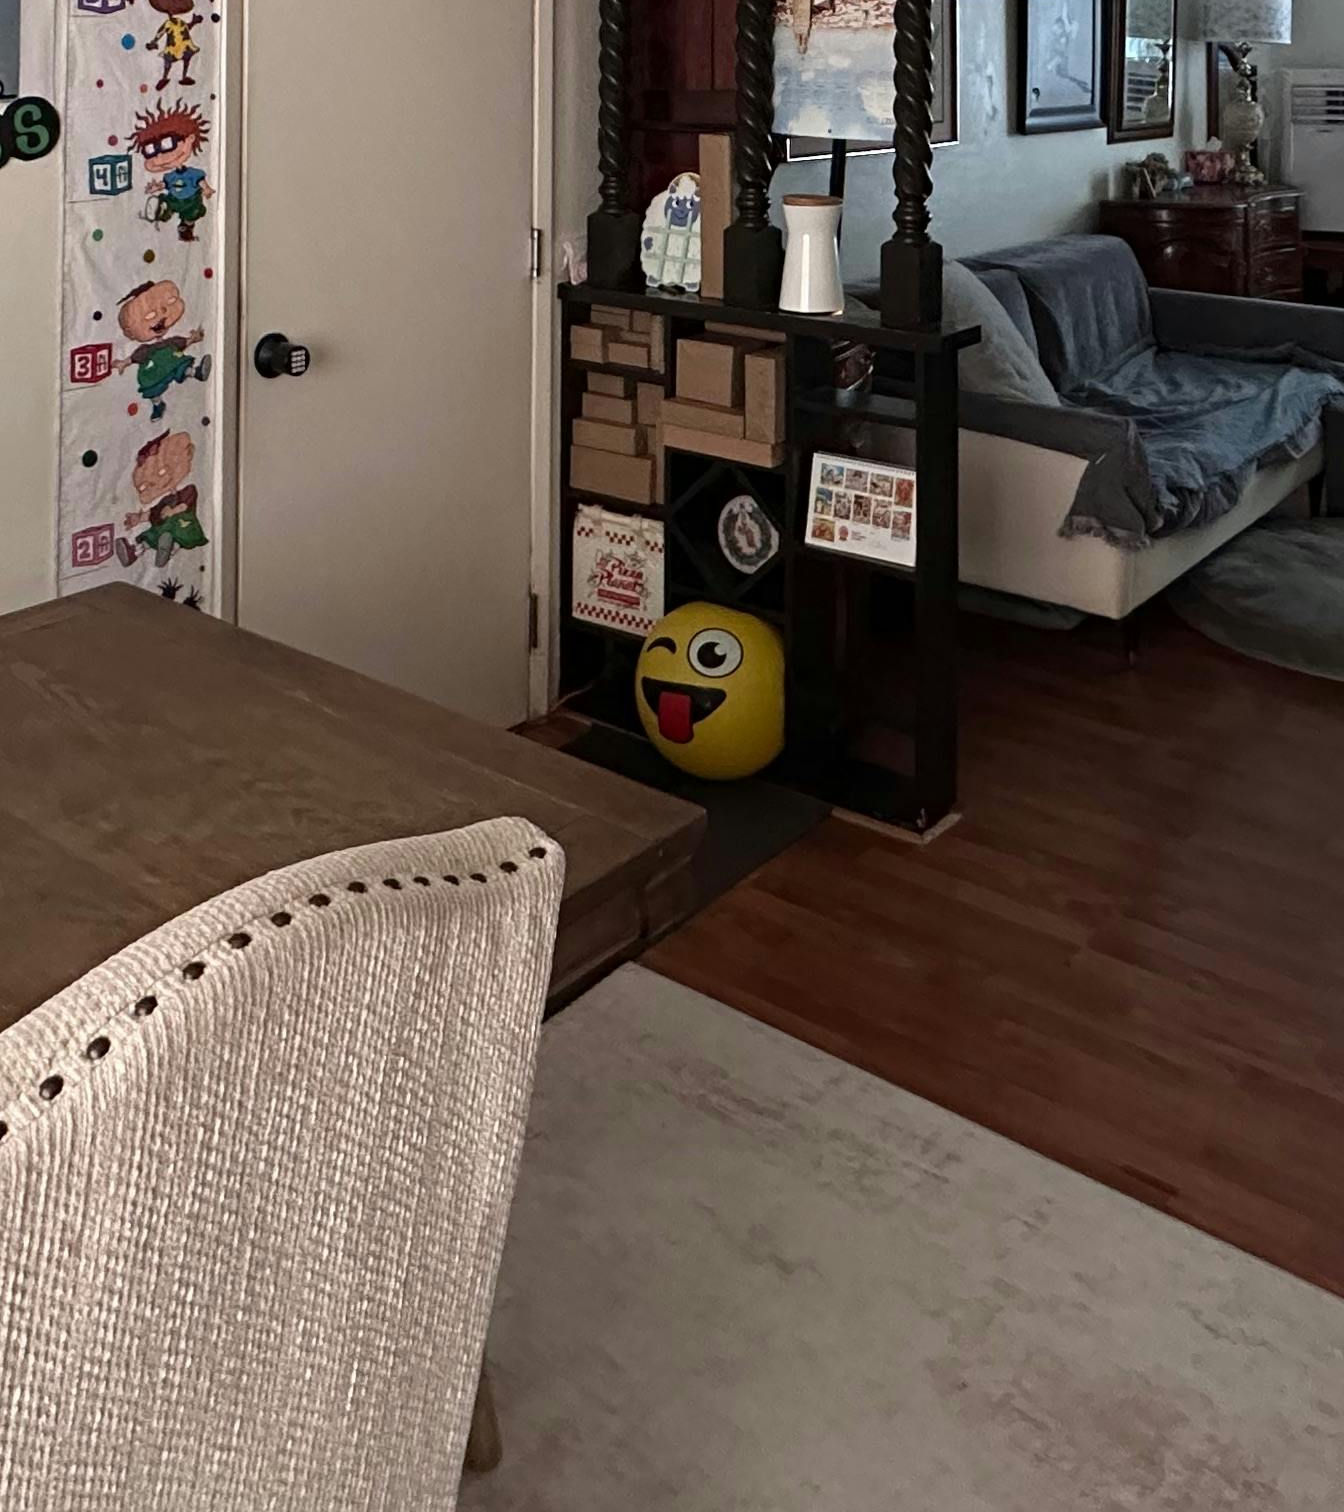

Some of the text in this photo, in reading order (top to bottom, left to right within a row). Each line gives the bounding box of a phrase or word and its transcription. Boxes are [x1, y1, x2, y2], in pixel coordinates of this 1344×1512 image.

[95, 167, 108, 186] 4
[76, 356, 92, 377] 3
[77, 541, 92, 562] 2
